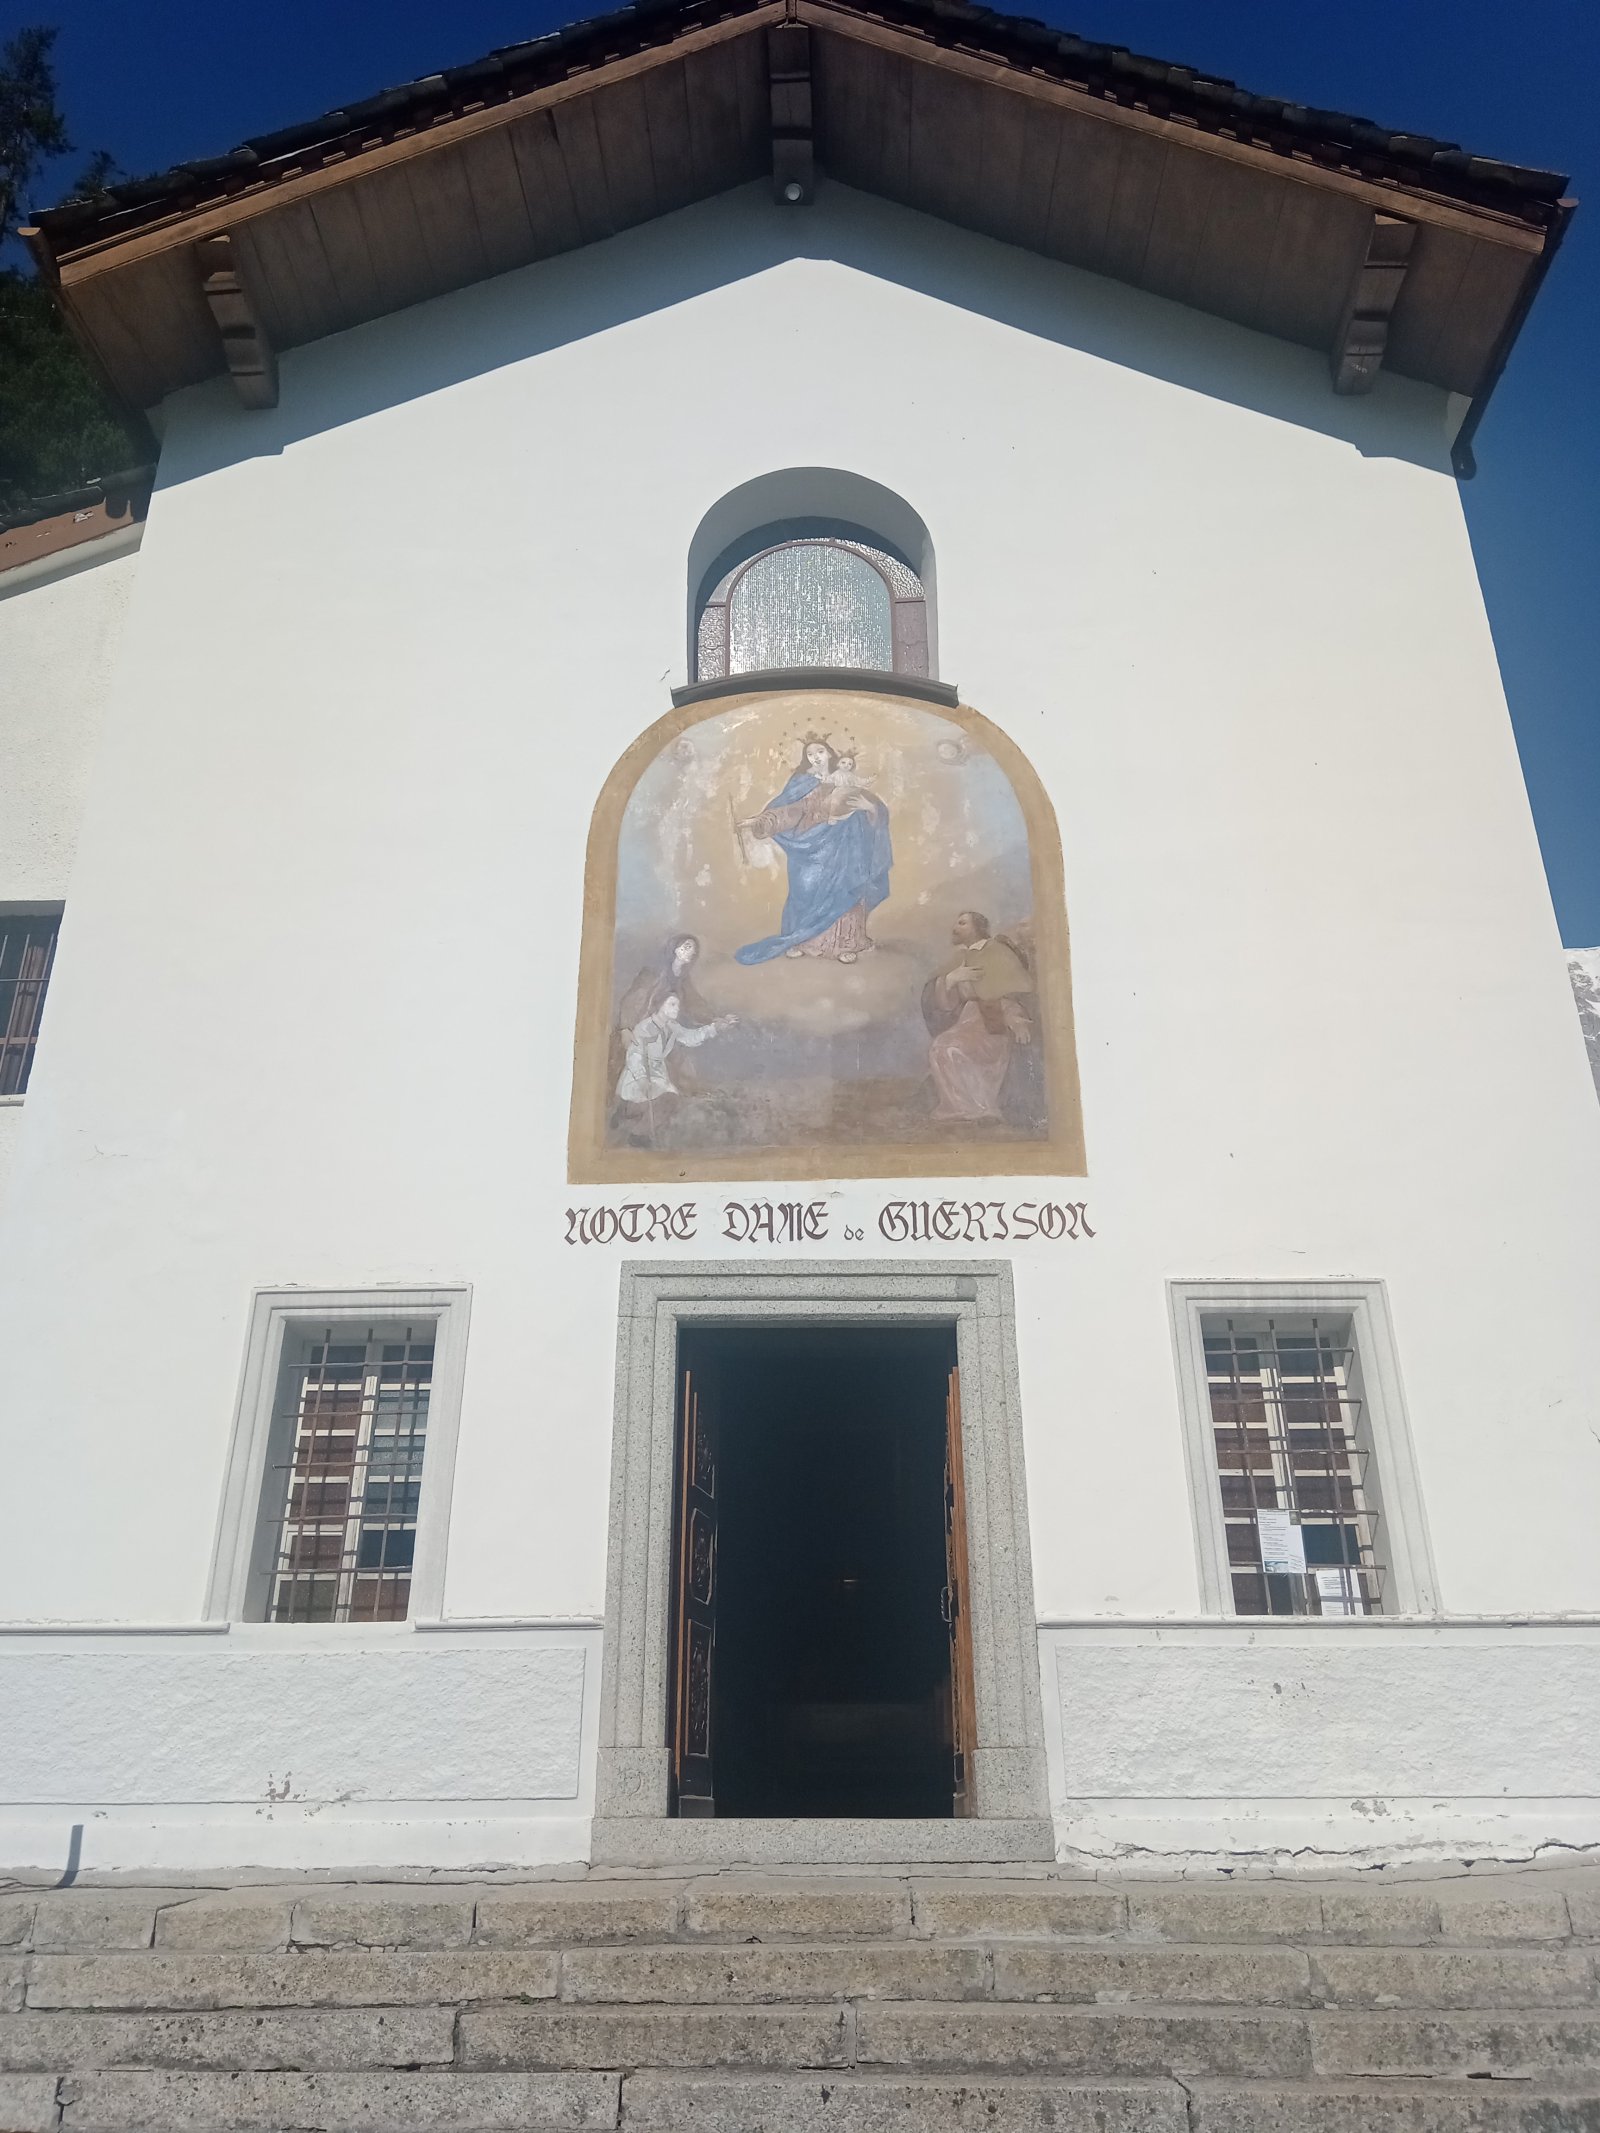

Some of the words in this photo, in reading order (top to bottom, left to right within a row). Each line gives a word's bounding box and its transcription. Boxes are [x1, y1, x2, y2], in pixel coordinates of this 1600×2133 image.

[564, 1203, 697, 1245] NOTRE
[722, 1201, 829, 1243] DAME
[843, 1224, 865, 1241] de
[878, 1201, 1097, 1241] GUERISON
